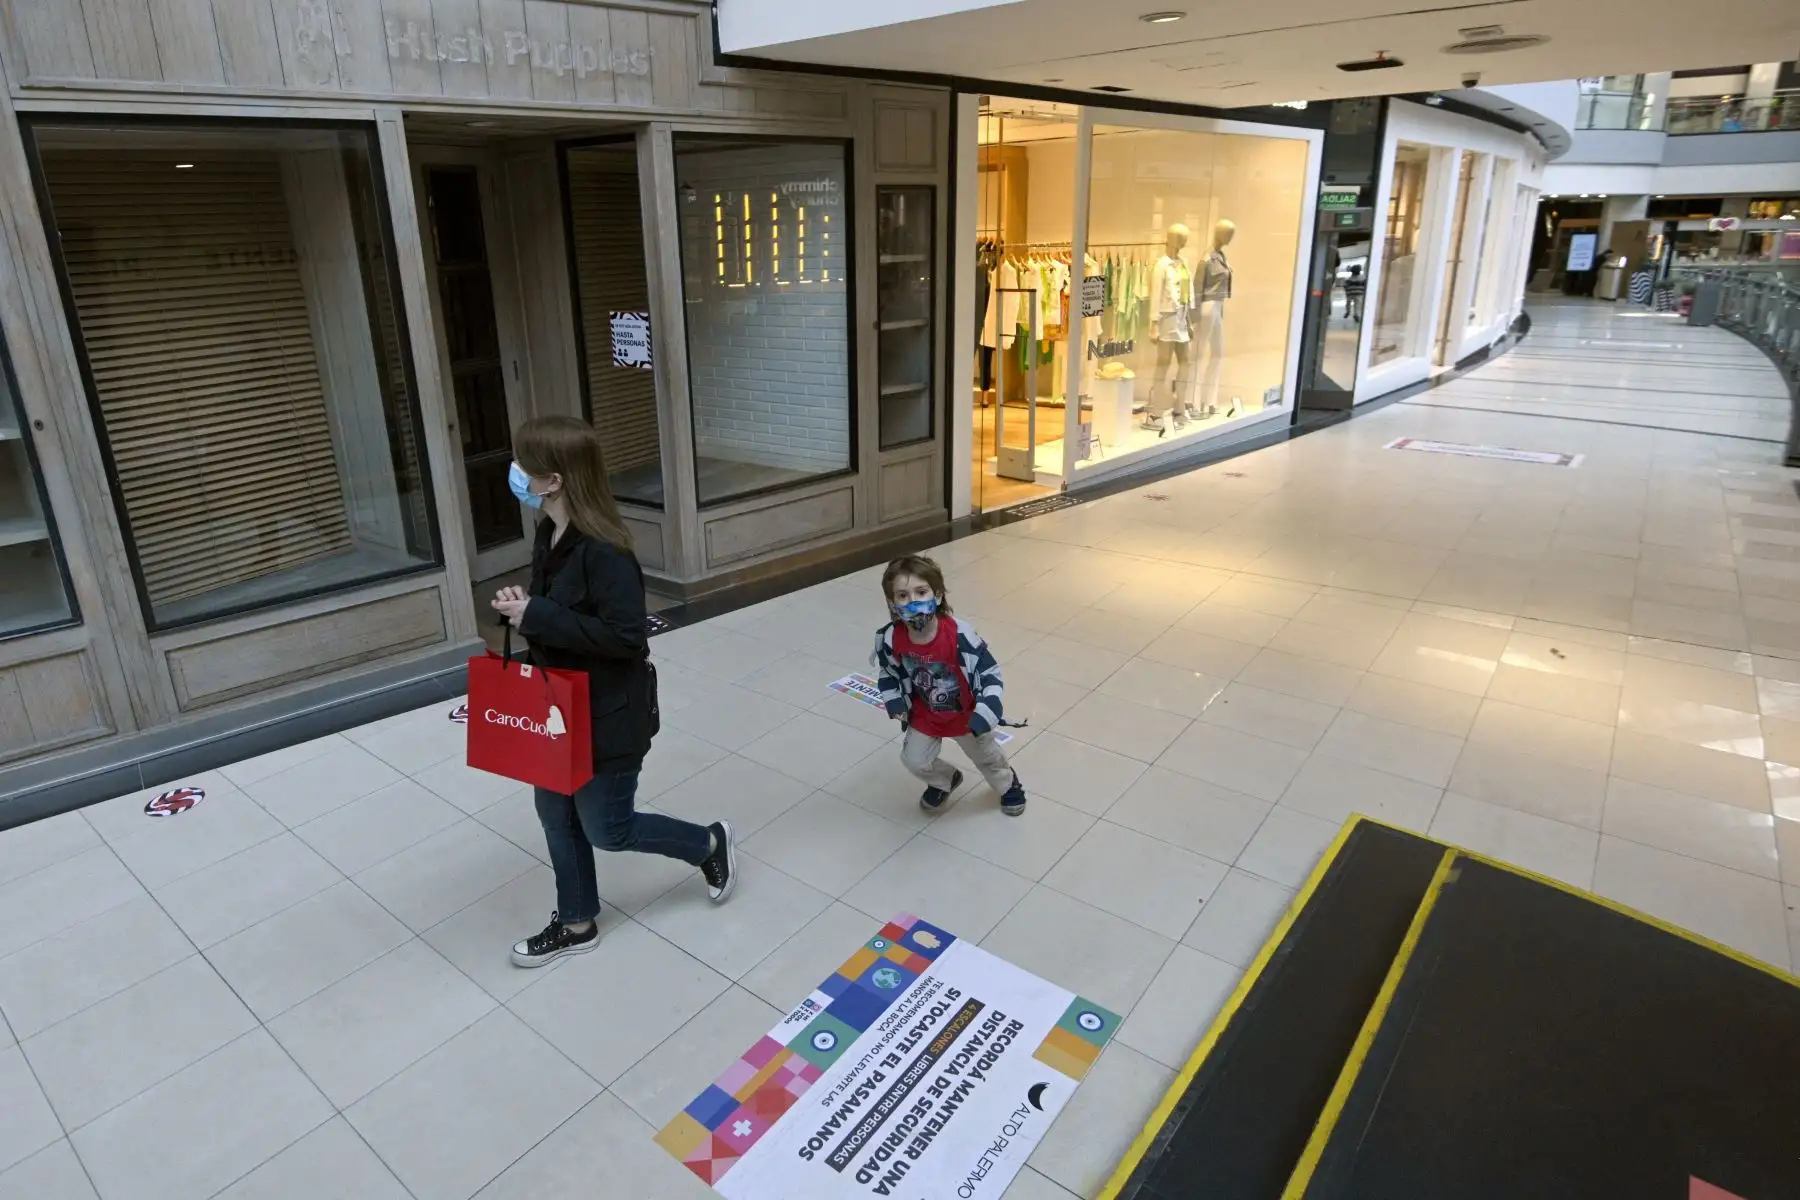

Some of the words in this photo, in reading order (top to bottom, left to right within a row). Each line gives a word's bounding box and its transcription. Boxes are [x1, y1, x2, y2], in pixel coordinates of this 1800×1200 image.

[385, 20, 494, 66] Hush
[504, 30, 650, 79] Puppies
[616, 331, 634, 339] HASTA
[616, 339, 646, 347] PERSONAS
[909, 975, 935, 1000] MANOS
[932, 980, 945, 990] TE
[943, 987, 962, 1002] SI
[876, 1012, 899, 1032] BOCA
[881, 989, 936, 1044] RECOMENDAMOS
[895, 1003, 908, 1013] LA
[895, 1000, 952, 1055] TOCASTE
[929, 1008, 973, 1055] ESCALONES
[943, 1010, 1008, 1077] DISTANCIA
[870, 1042, 885, 1055] NO
[879, 1052, 903, 1069] EL
[967, 1018, 1025, 1083] RECORDÁ
[836, 1052, 874, 1092] LLEVARTE
[903, 1054, 933, 1085] LIBRES
[926, 1075, 952, 1099] DE
[798, 1069, 887, 1162] PASAMANOS
[821, 1089, 840, 1107] LAS
[877, 1084, 908, 1114] ENTRE
[902, 1079, 976, 1161] MANTENER
[1002, 1101, 1031, 1137] ALTO
[833, 1114, 882, 1165] PERSONAS
[855, 1096, 934, 1185] SEGURIDAD
[871, 1160, 911, 1196] UNA
[957, 1135, 1009, 1199] PALERMO
